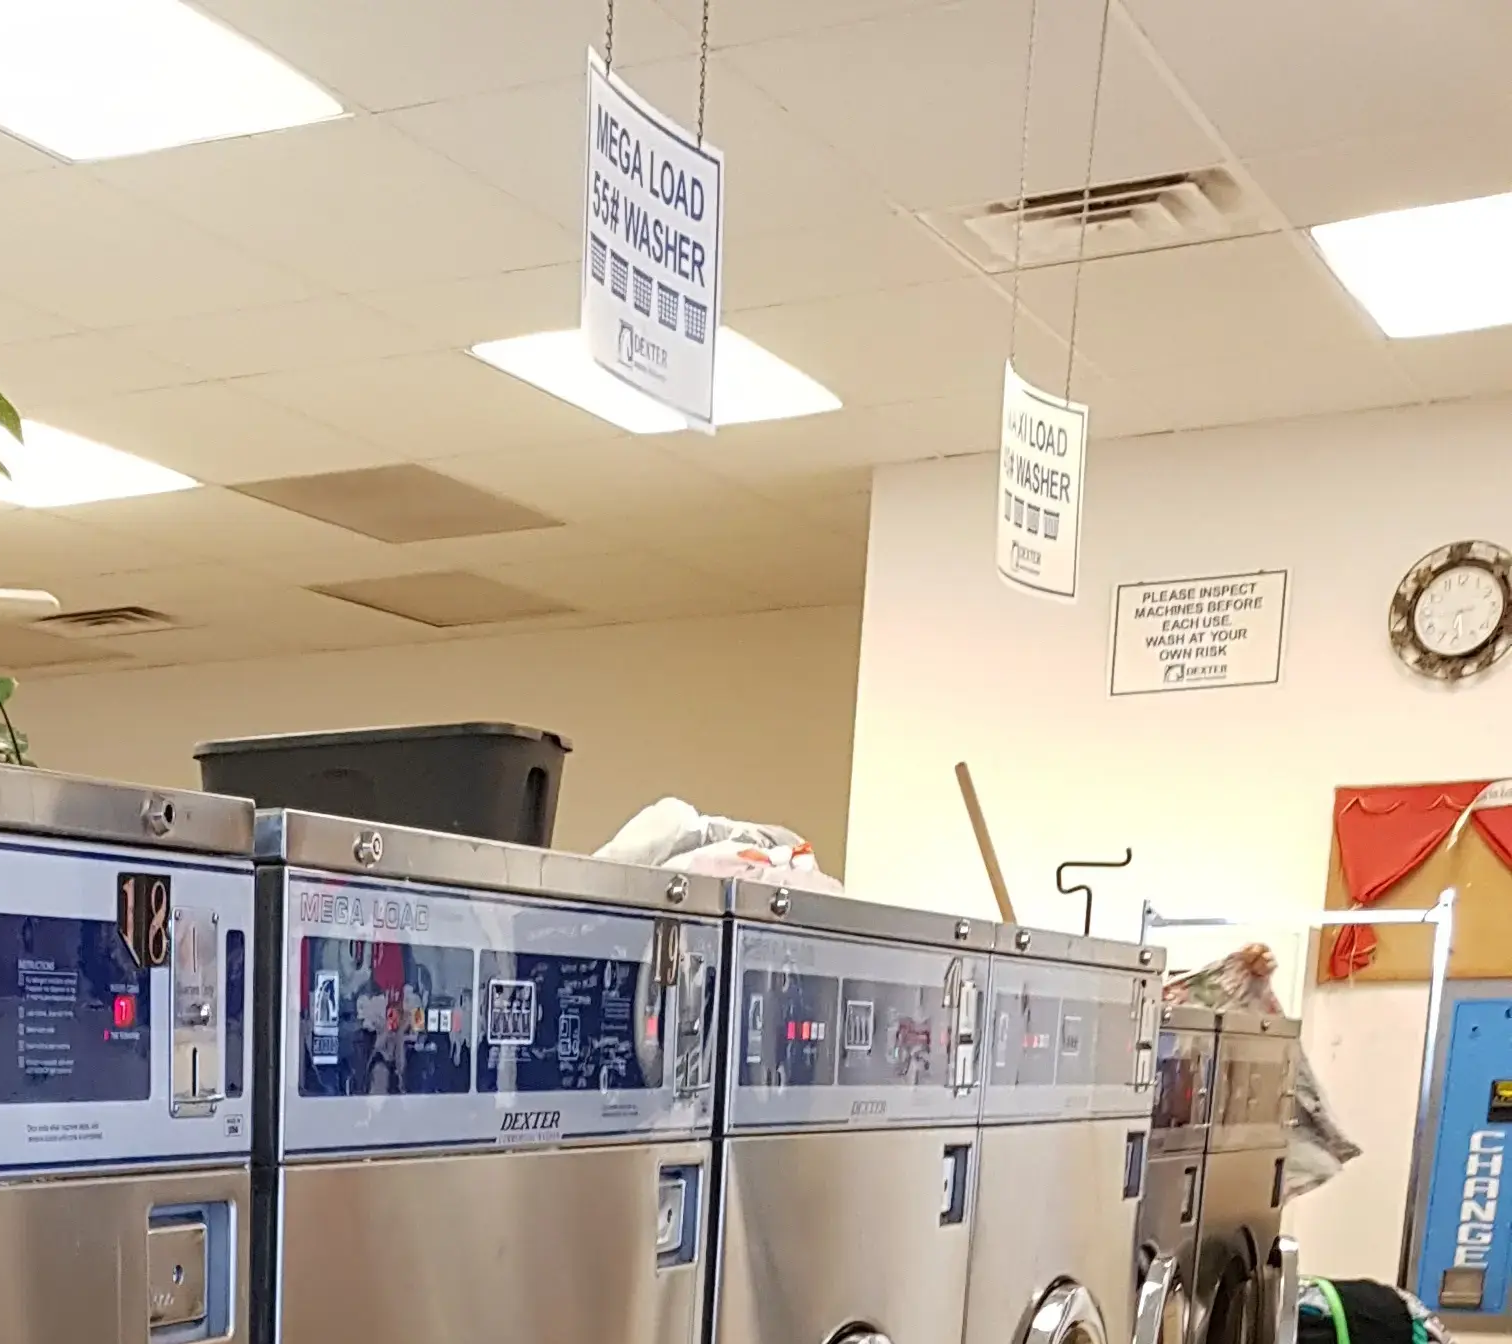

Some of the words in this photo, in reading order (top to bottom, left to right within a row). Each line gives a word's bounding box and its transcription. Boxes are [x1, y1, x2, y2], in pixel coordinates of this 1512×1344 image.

[597, 103, 643, 188] MEGA
[650, 150, 705, 222] LOAD
[593, 170, 620, 235] 55#
[624, 196, 706, 288] WASHER
[633, 333, 668, 368] DEXTER
[1029, 417, 1067, 457] LOAD
[1016, 453, 1070, 503] WASHER
[1134, 601, 1204, 619] MACHINES
[1207, 596, 1264, 614] BEFORE
[1142, 588, 1196, 603] PLEASE
[1199, 582, 1257, 598] INSPECT
[1145, 634, 1185, 648] WASH
[1189, 631, 1206, 645] AT
[1210, 628, 1248, 642] YOUR
[1162, 617, 1199, 632] EACH
[1159, 648, 1192, 662] OWN
[1195, 645, 1227, 659] RISK
[122, 877, 168, 966] 18
[300, 892, 365, 926] MEGA
[372, 900, 430, 931] LOAD
[654, 922, 679, 985] 19
[500, 1110, 561, 1131] DEXTER
[1454, 1130, 1506, 1269] CHANGE
